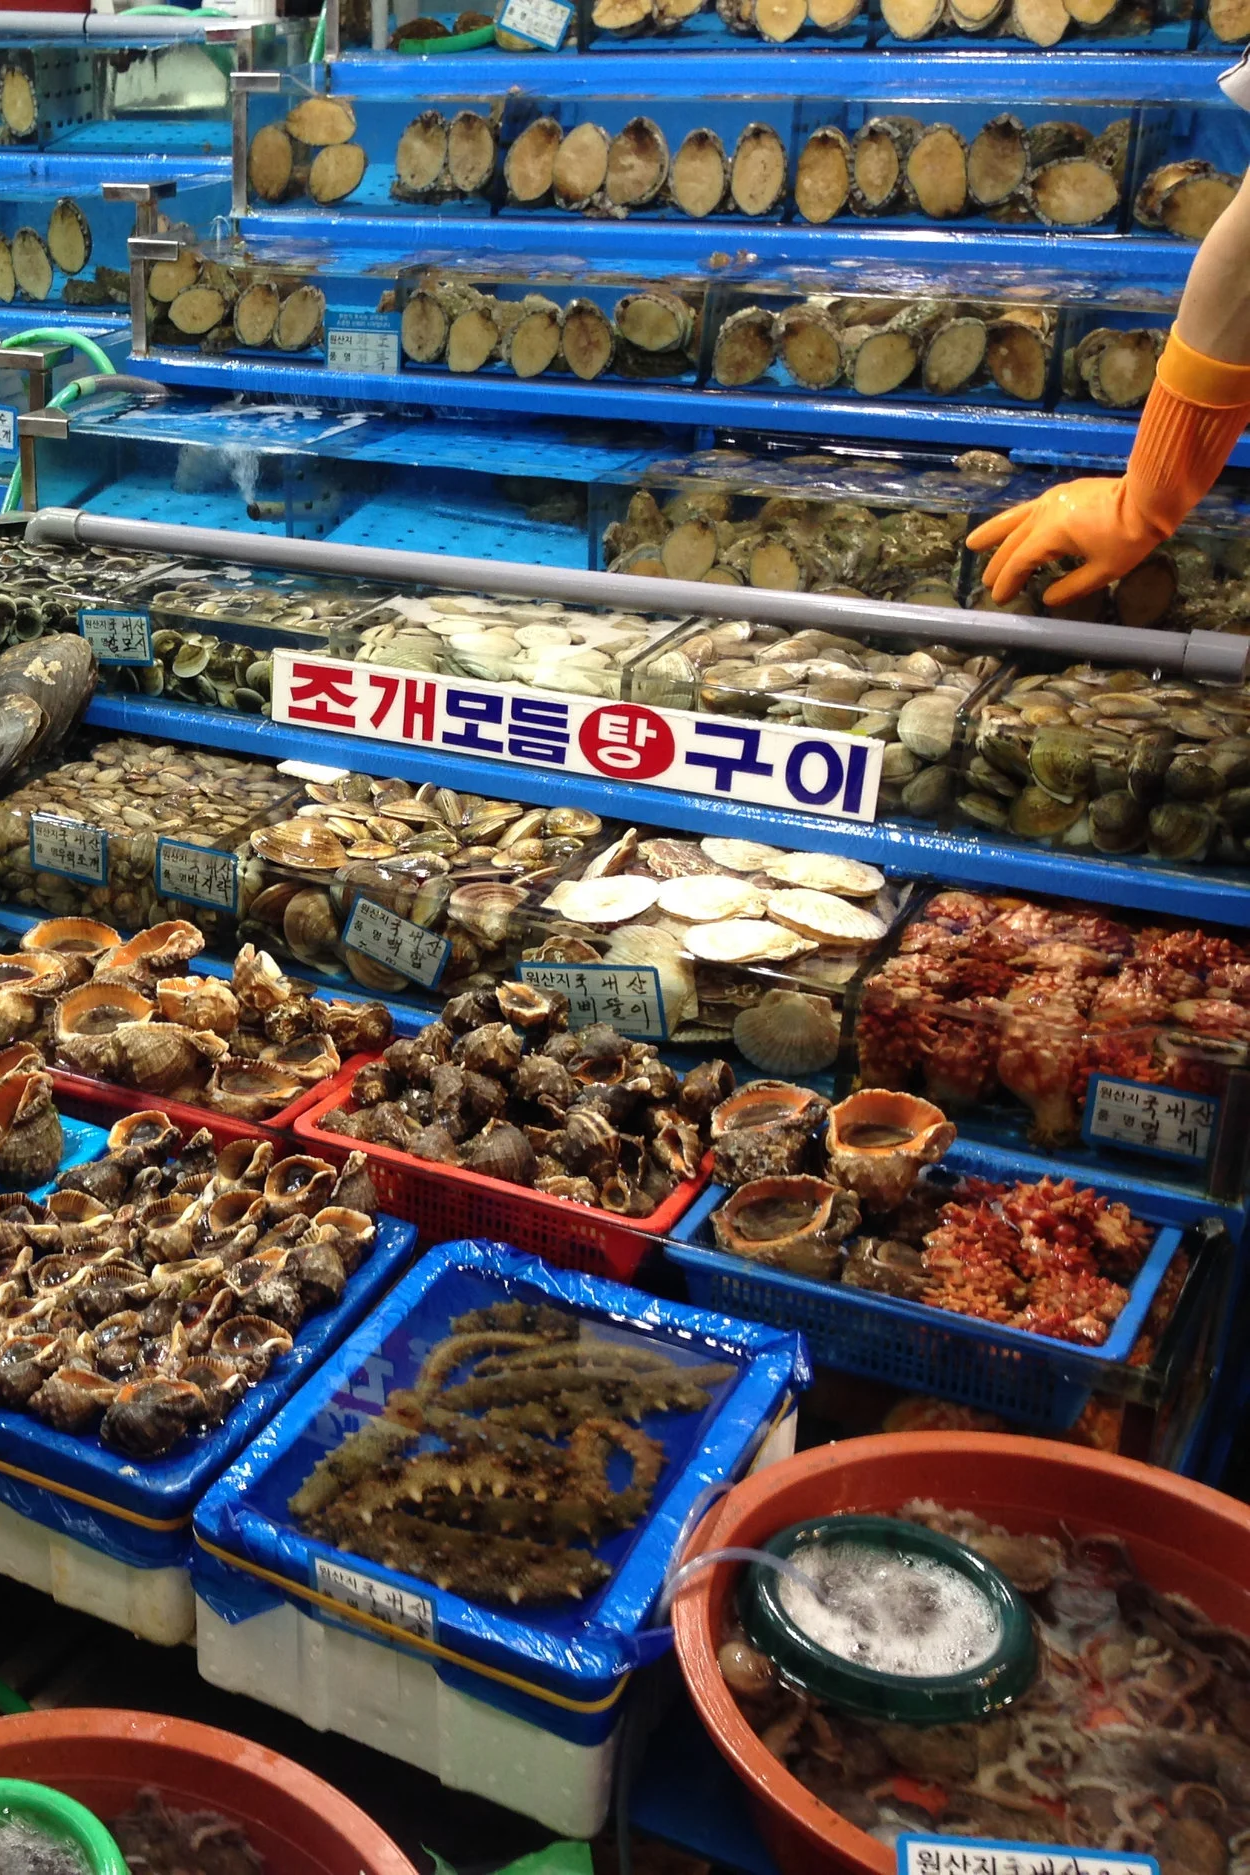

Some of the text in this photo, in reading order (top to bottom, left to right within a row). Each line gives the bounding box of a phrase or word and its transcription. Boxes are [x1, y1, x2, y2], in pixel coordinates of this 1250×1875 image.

[85, 619, 106, 630] 원산지
[360, 902, 442, 957] 원산지 국내산
[526, 971, 647, 998] 원산지 국내산
[1099, 1086, 1211, 1128] 원산지 국내산
